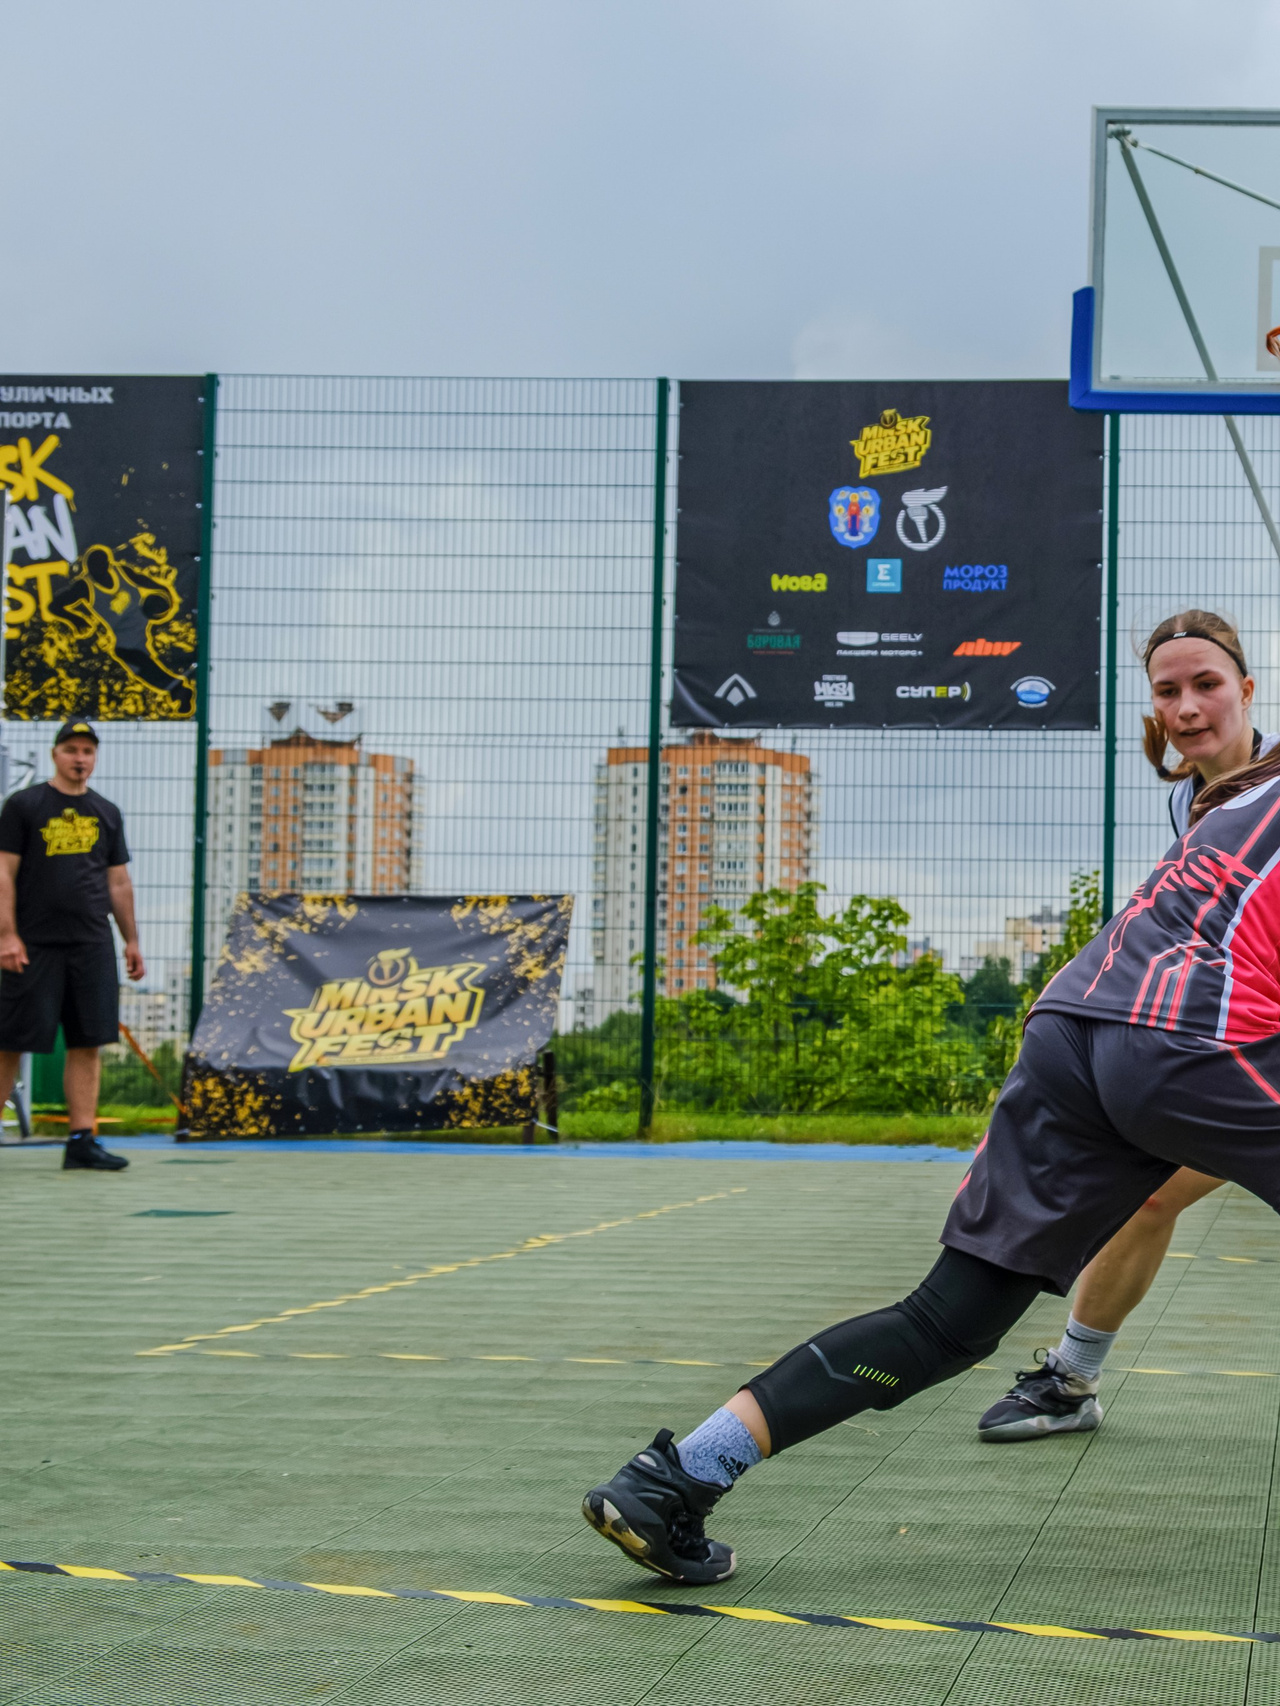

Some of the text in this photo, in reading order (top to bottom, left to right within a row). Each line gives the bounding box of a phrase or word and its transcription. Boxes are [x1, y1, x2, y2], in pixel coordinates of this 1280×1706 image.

[861, 418, 922, 440] MINSK
[858, 430, 927, 455] URBAN
[863, 445, 920, 472] FEST
[944, 564, 1008, 579] МОРОЗ
[943, 579, 1007, 592] ПРОДУКТ
[880, 632, 923, 643] GEELY
[896, 685, 962, 698] СУПЕР
[313, 967, 470, 1012] MINSK
[299, 991, 472, 1039] URBAN
[302, 1023, 452, 1063] FEST
